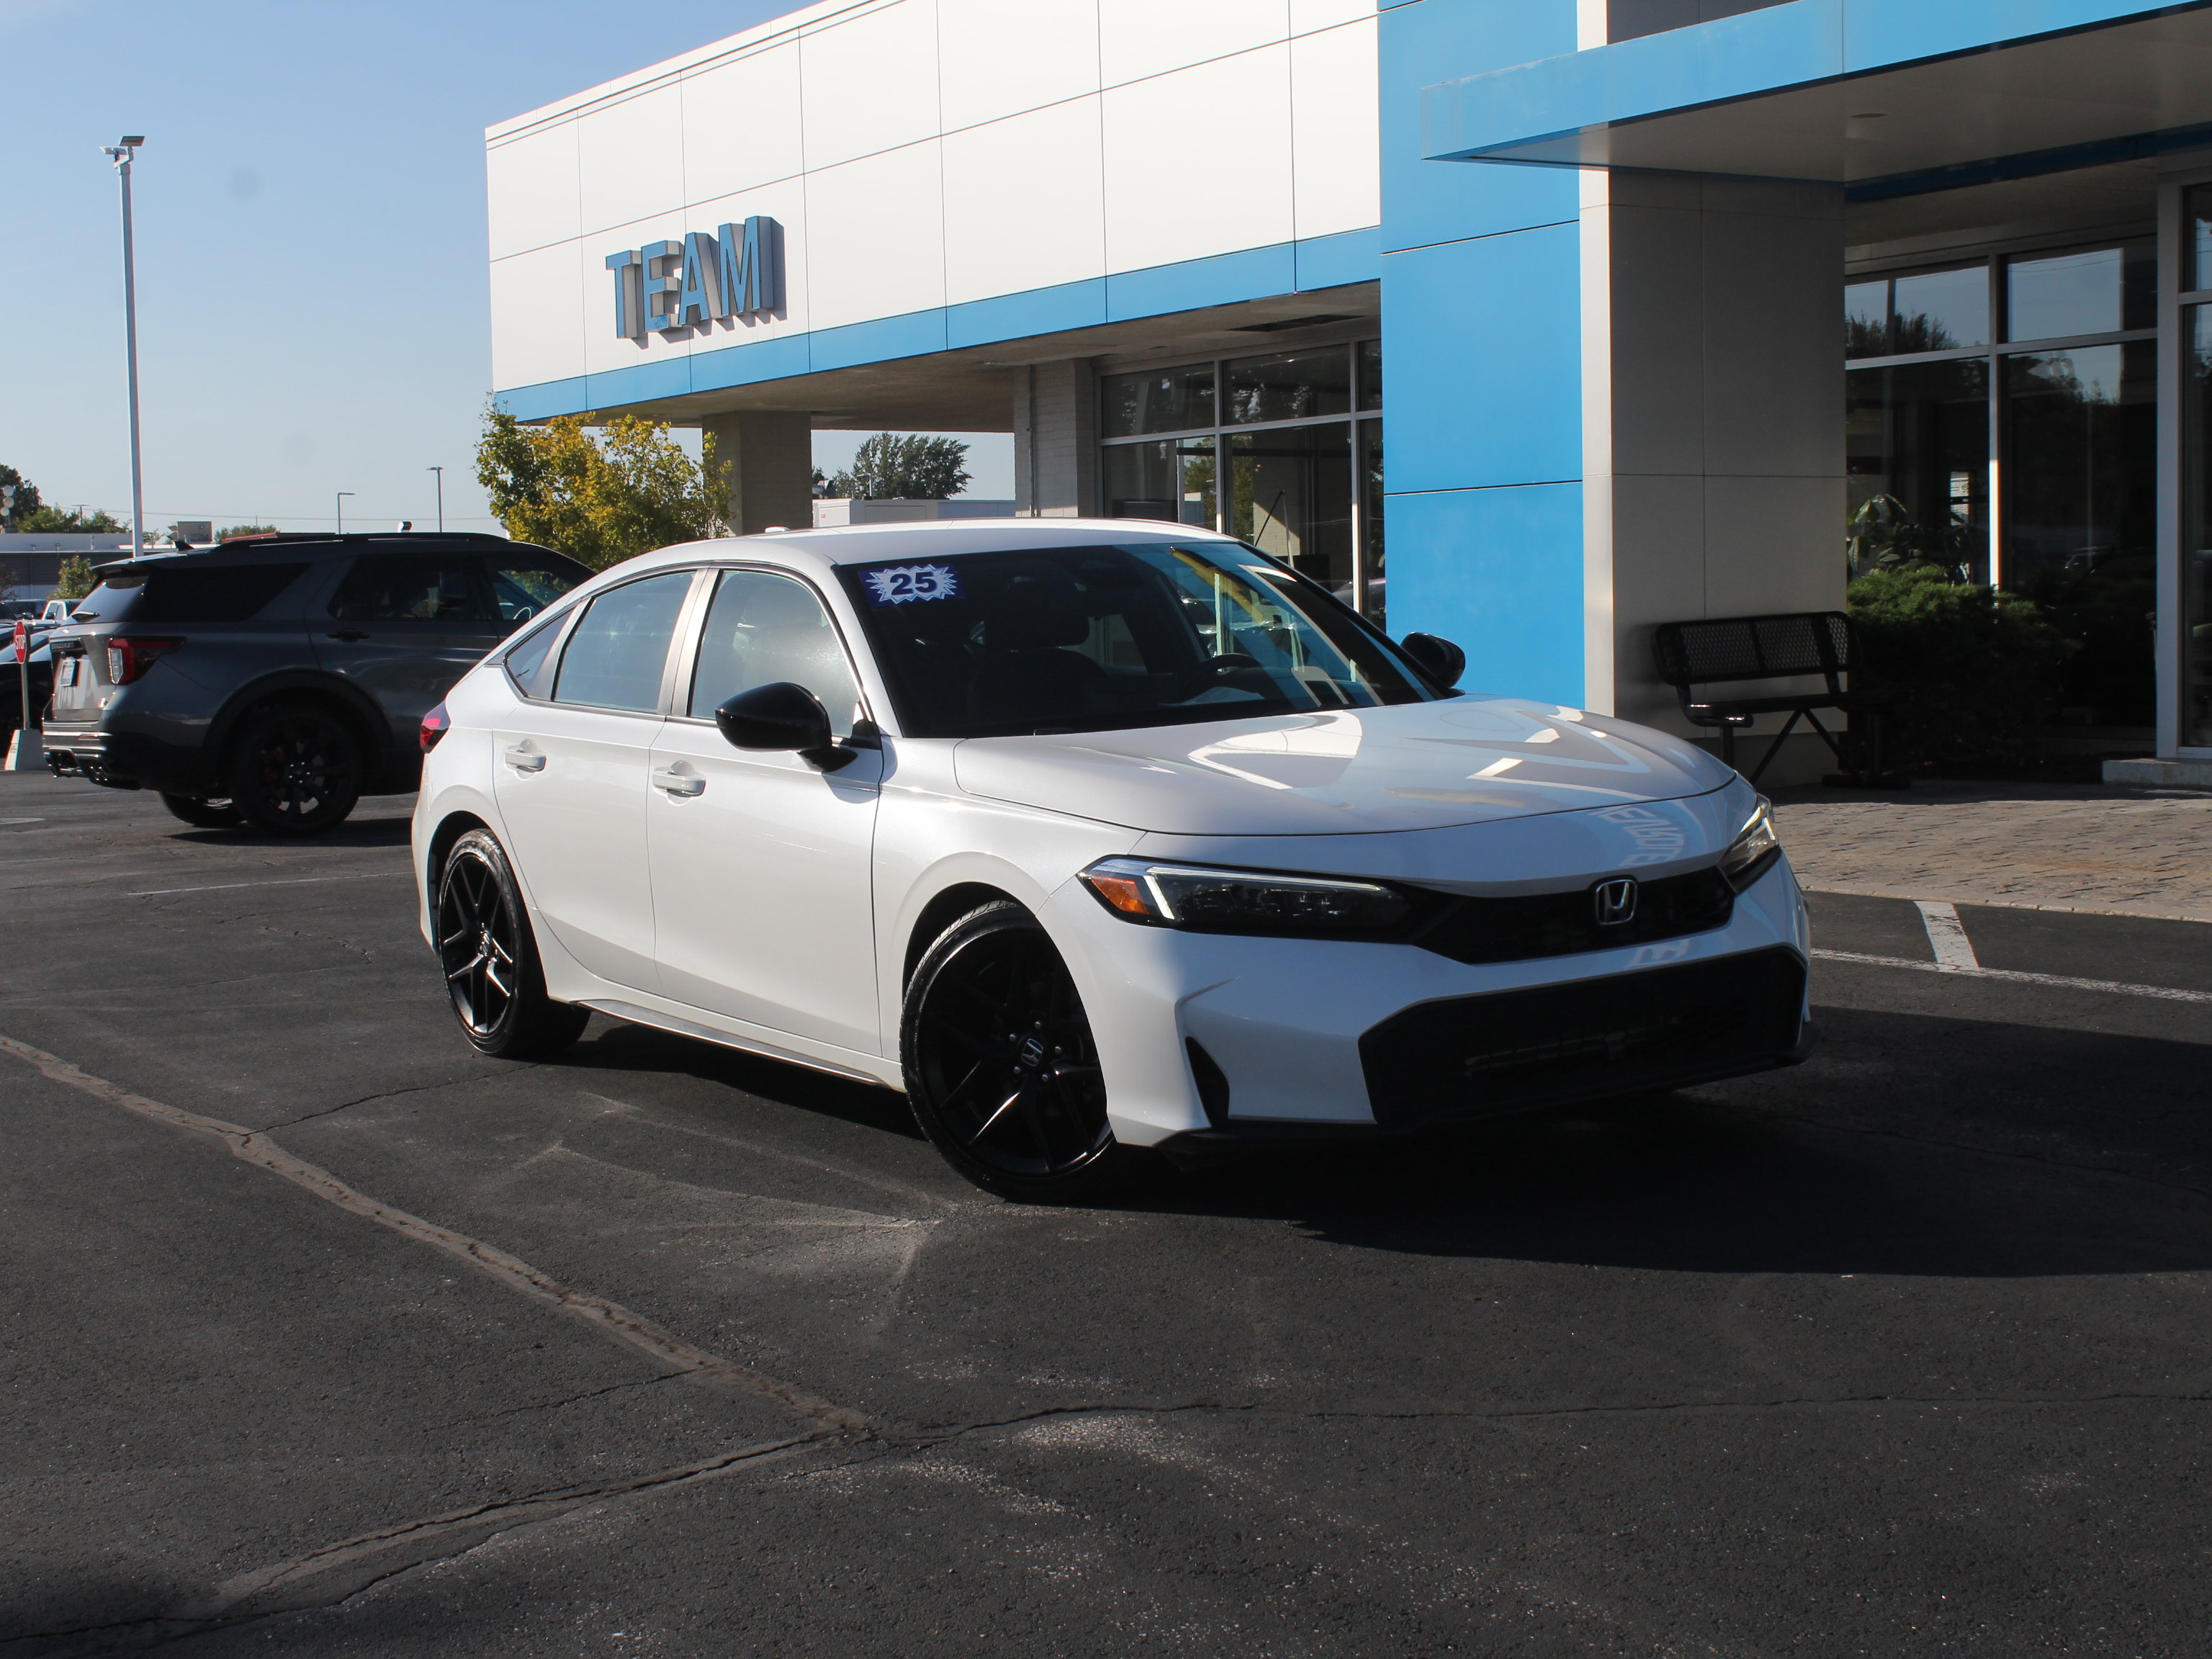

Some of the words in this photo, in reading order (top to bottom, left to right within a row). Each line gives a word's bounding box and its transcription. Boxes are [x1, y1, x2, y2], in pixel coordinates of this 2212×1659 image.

[606, 215, 773, 338] TEAM
[889, 571, 938, 596] 25
[16, 634, 26, 649] STOP
